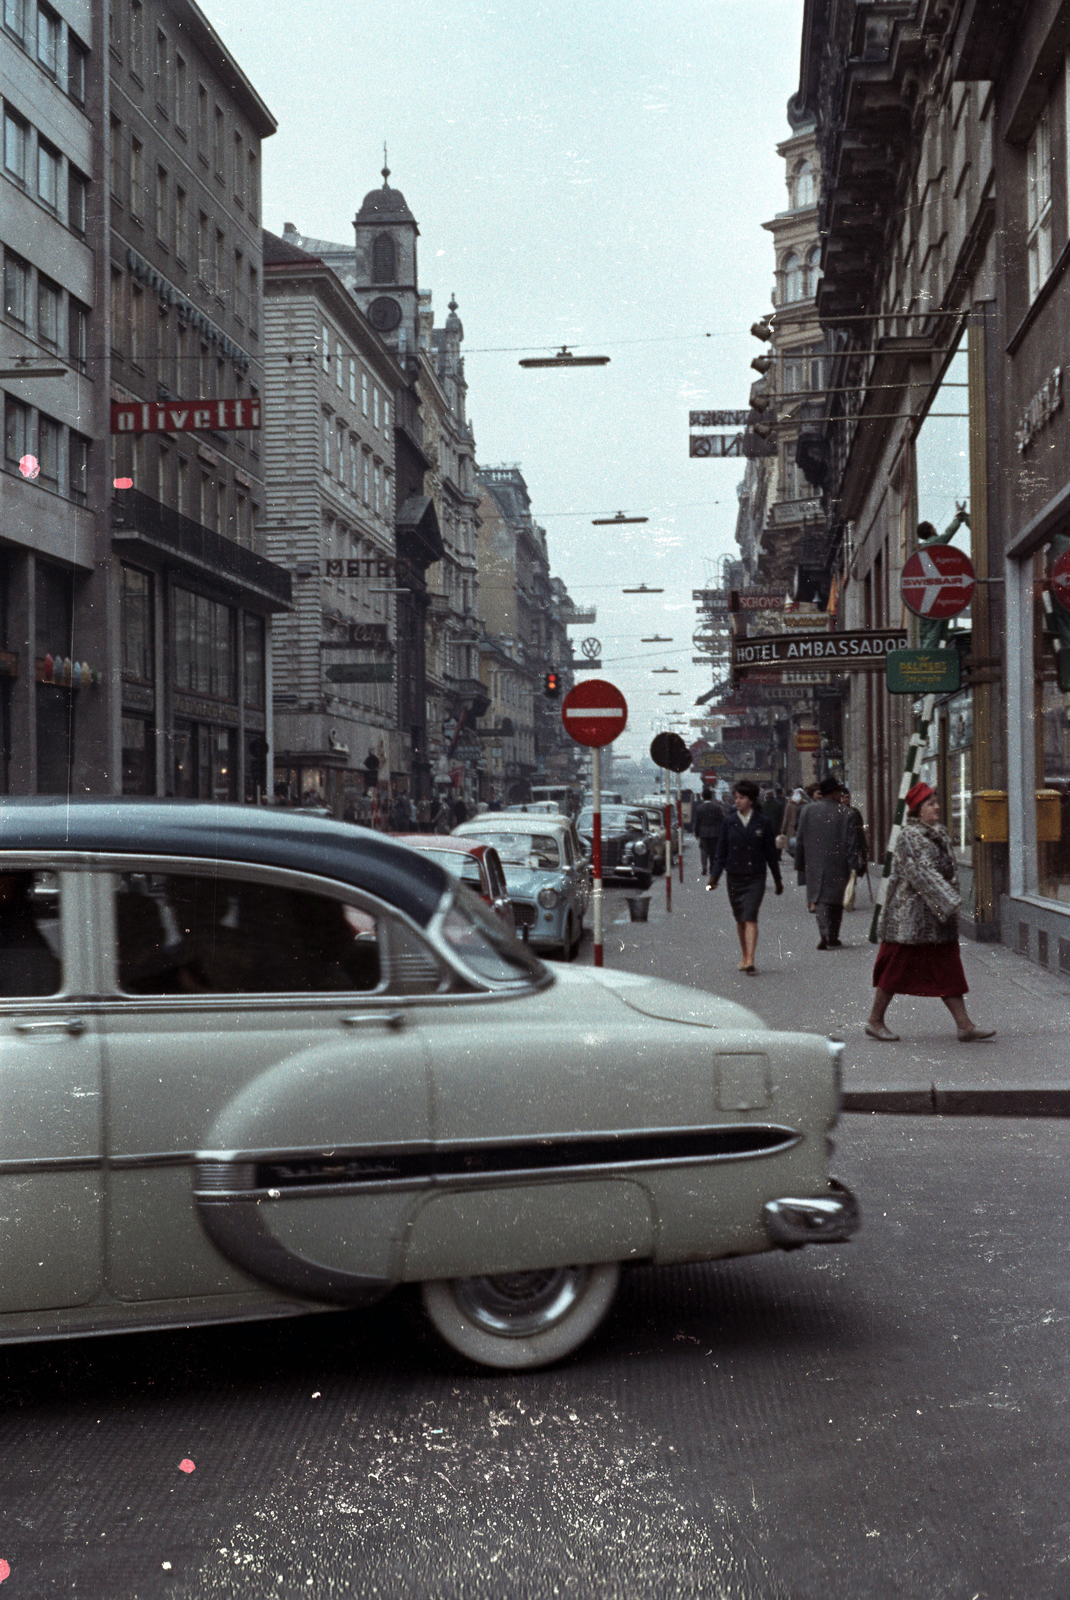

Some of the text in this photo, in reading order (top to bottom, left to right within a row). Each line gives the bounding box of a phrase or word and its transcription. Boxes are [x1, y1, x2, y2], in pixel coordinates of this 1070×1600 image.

[117, 400, 259, 430] olivetti
[903, 577, 963, 587] SWISSAIR
[736, 644, 781, 662] HOTEL
